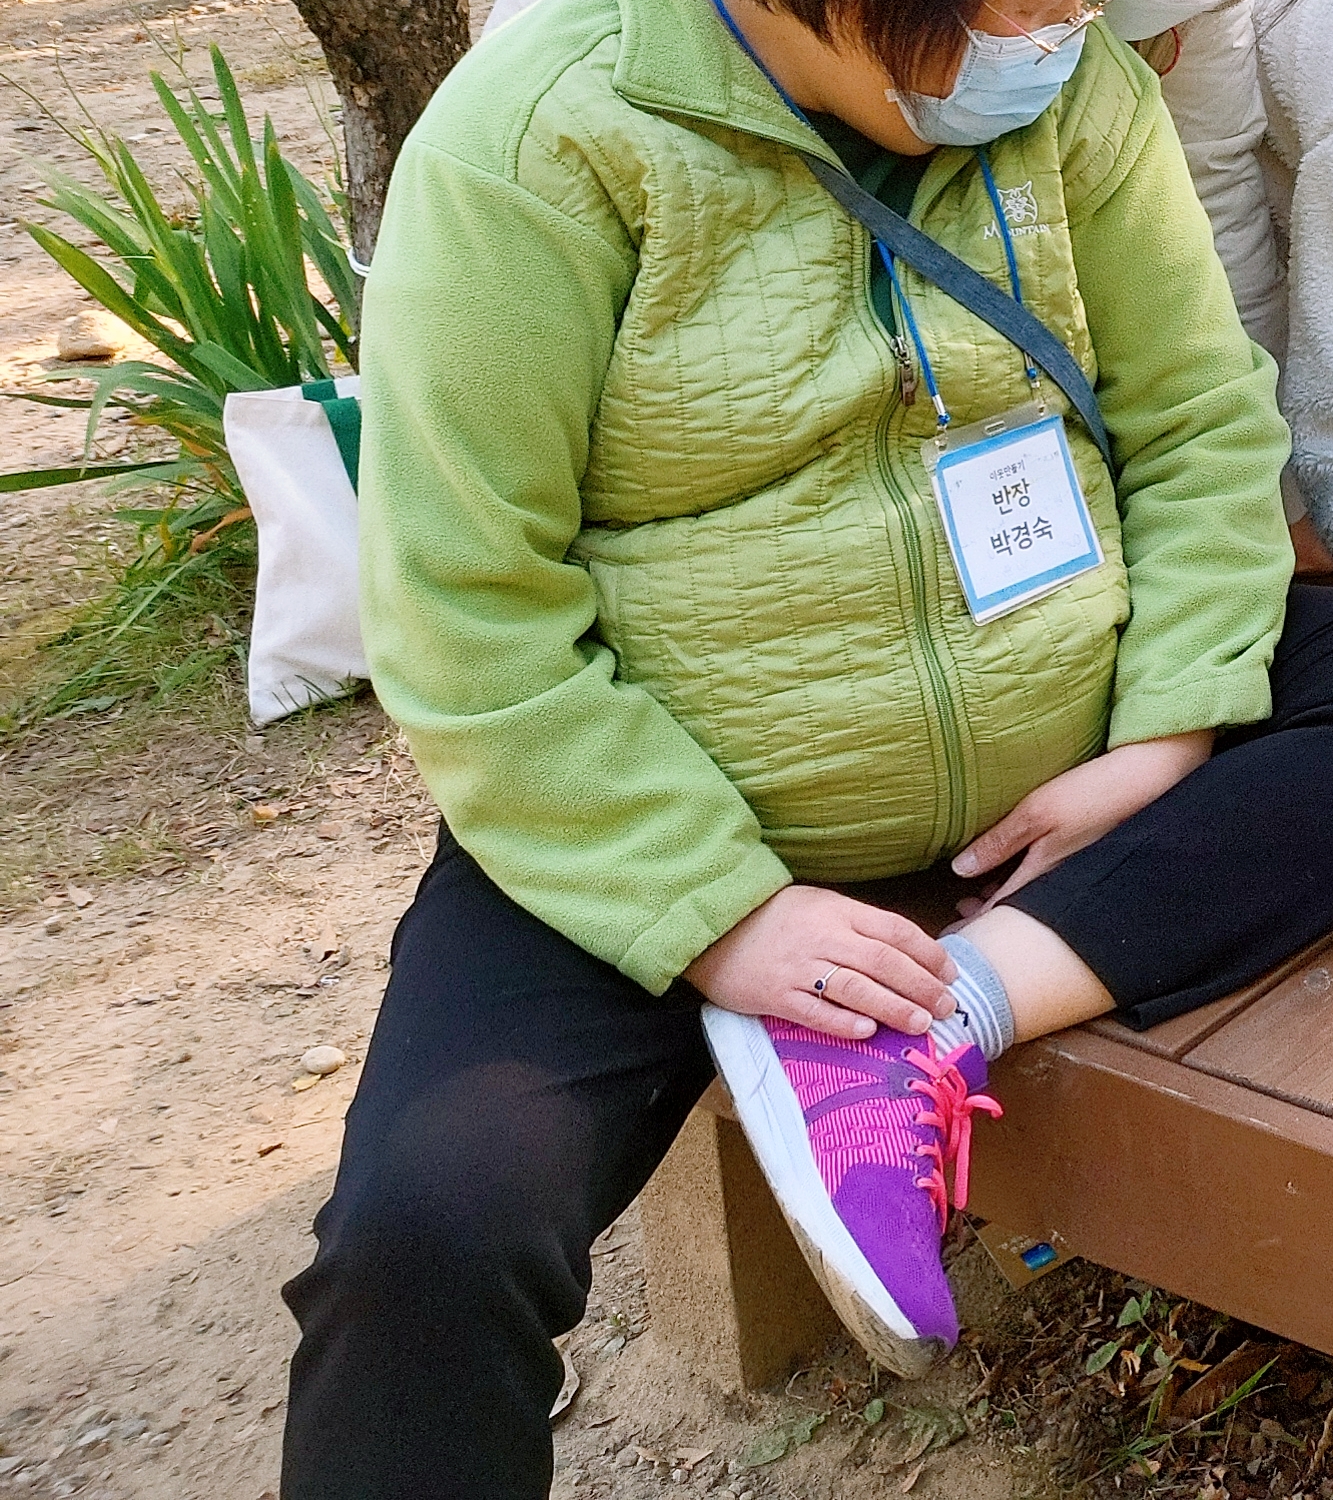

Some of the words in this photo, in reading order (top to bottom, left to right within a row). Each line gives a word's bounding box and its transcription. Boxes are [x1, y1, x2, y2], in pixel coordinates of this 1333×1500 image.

[983, 219, 1051, 240] MUNTAIN
[991, 478, 1031, 516] 반장
[989, 516, 1054, 557] 박경숙
